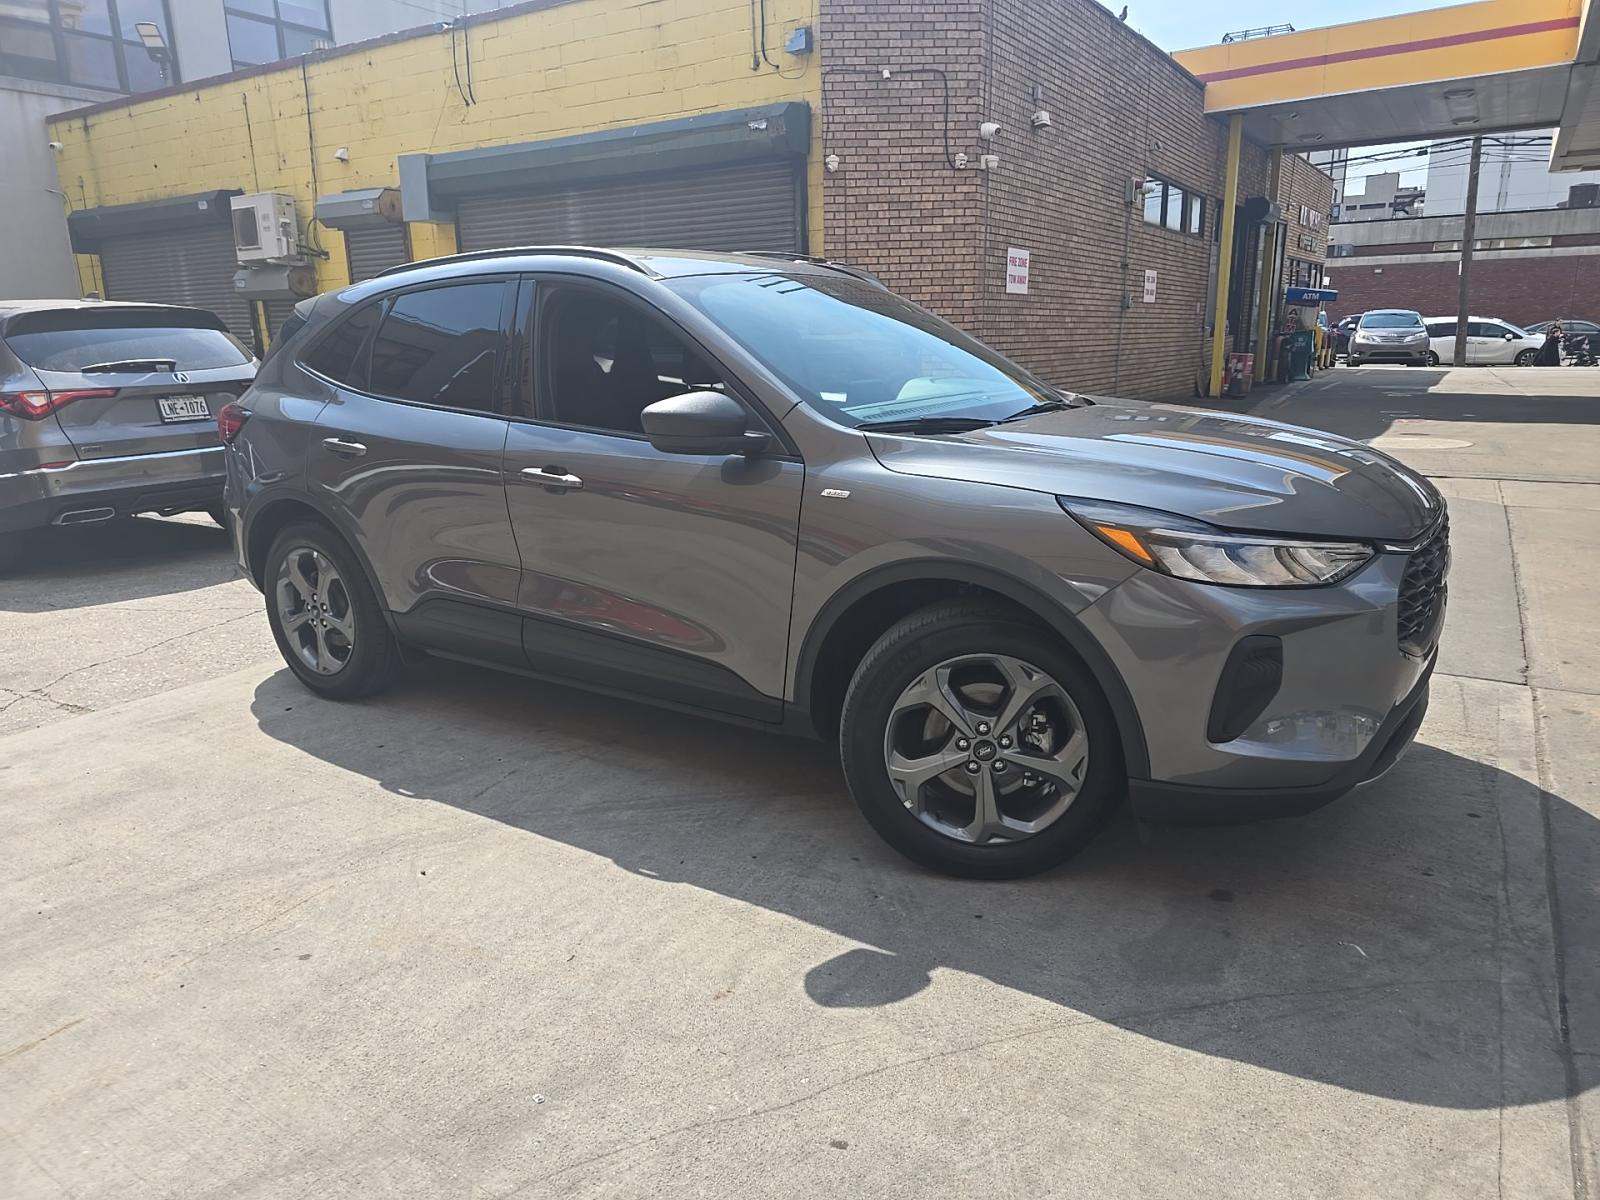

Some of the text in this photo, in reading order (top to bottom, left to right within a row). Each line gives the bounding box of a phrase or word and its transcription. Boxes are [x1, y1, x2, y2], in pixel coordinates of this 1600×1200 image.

[1009, 256, 1028, 268] FIRE ZONE
[1008, 274, 1027, 285] TOW AWAY
[1302, 292, 1320, 300] ATM
